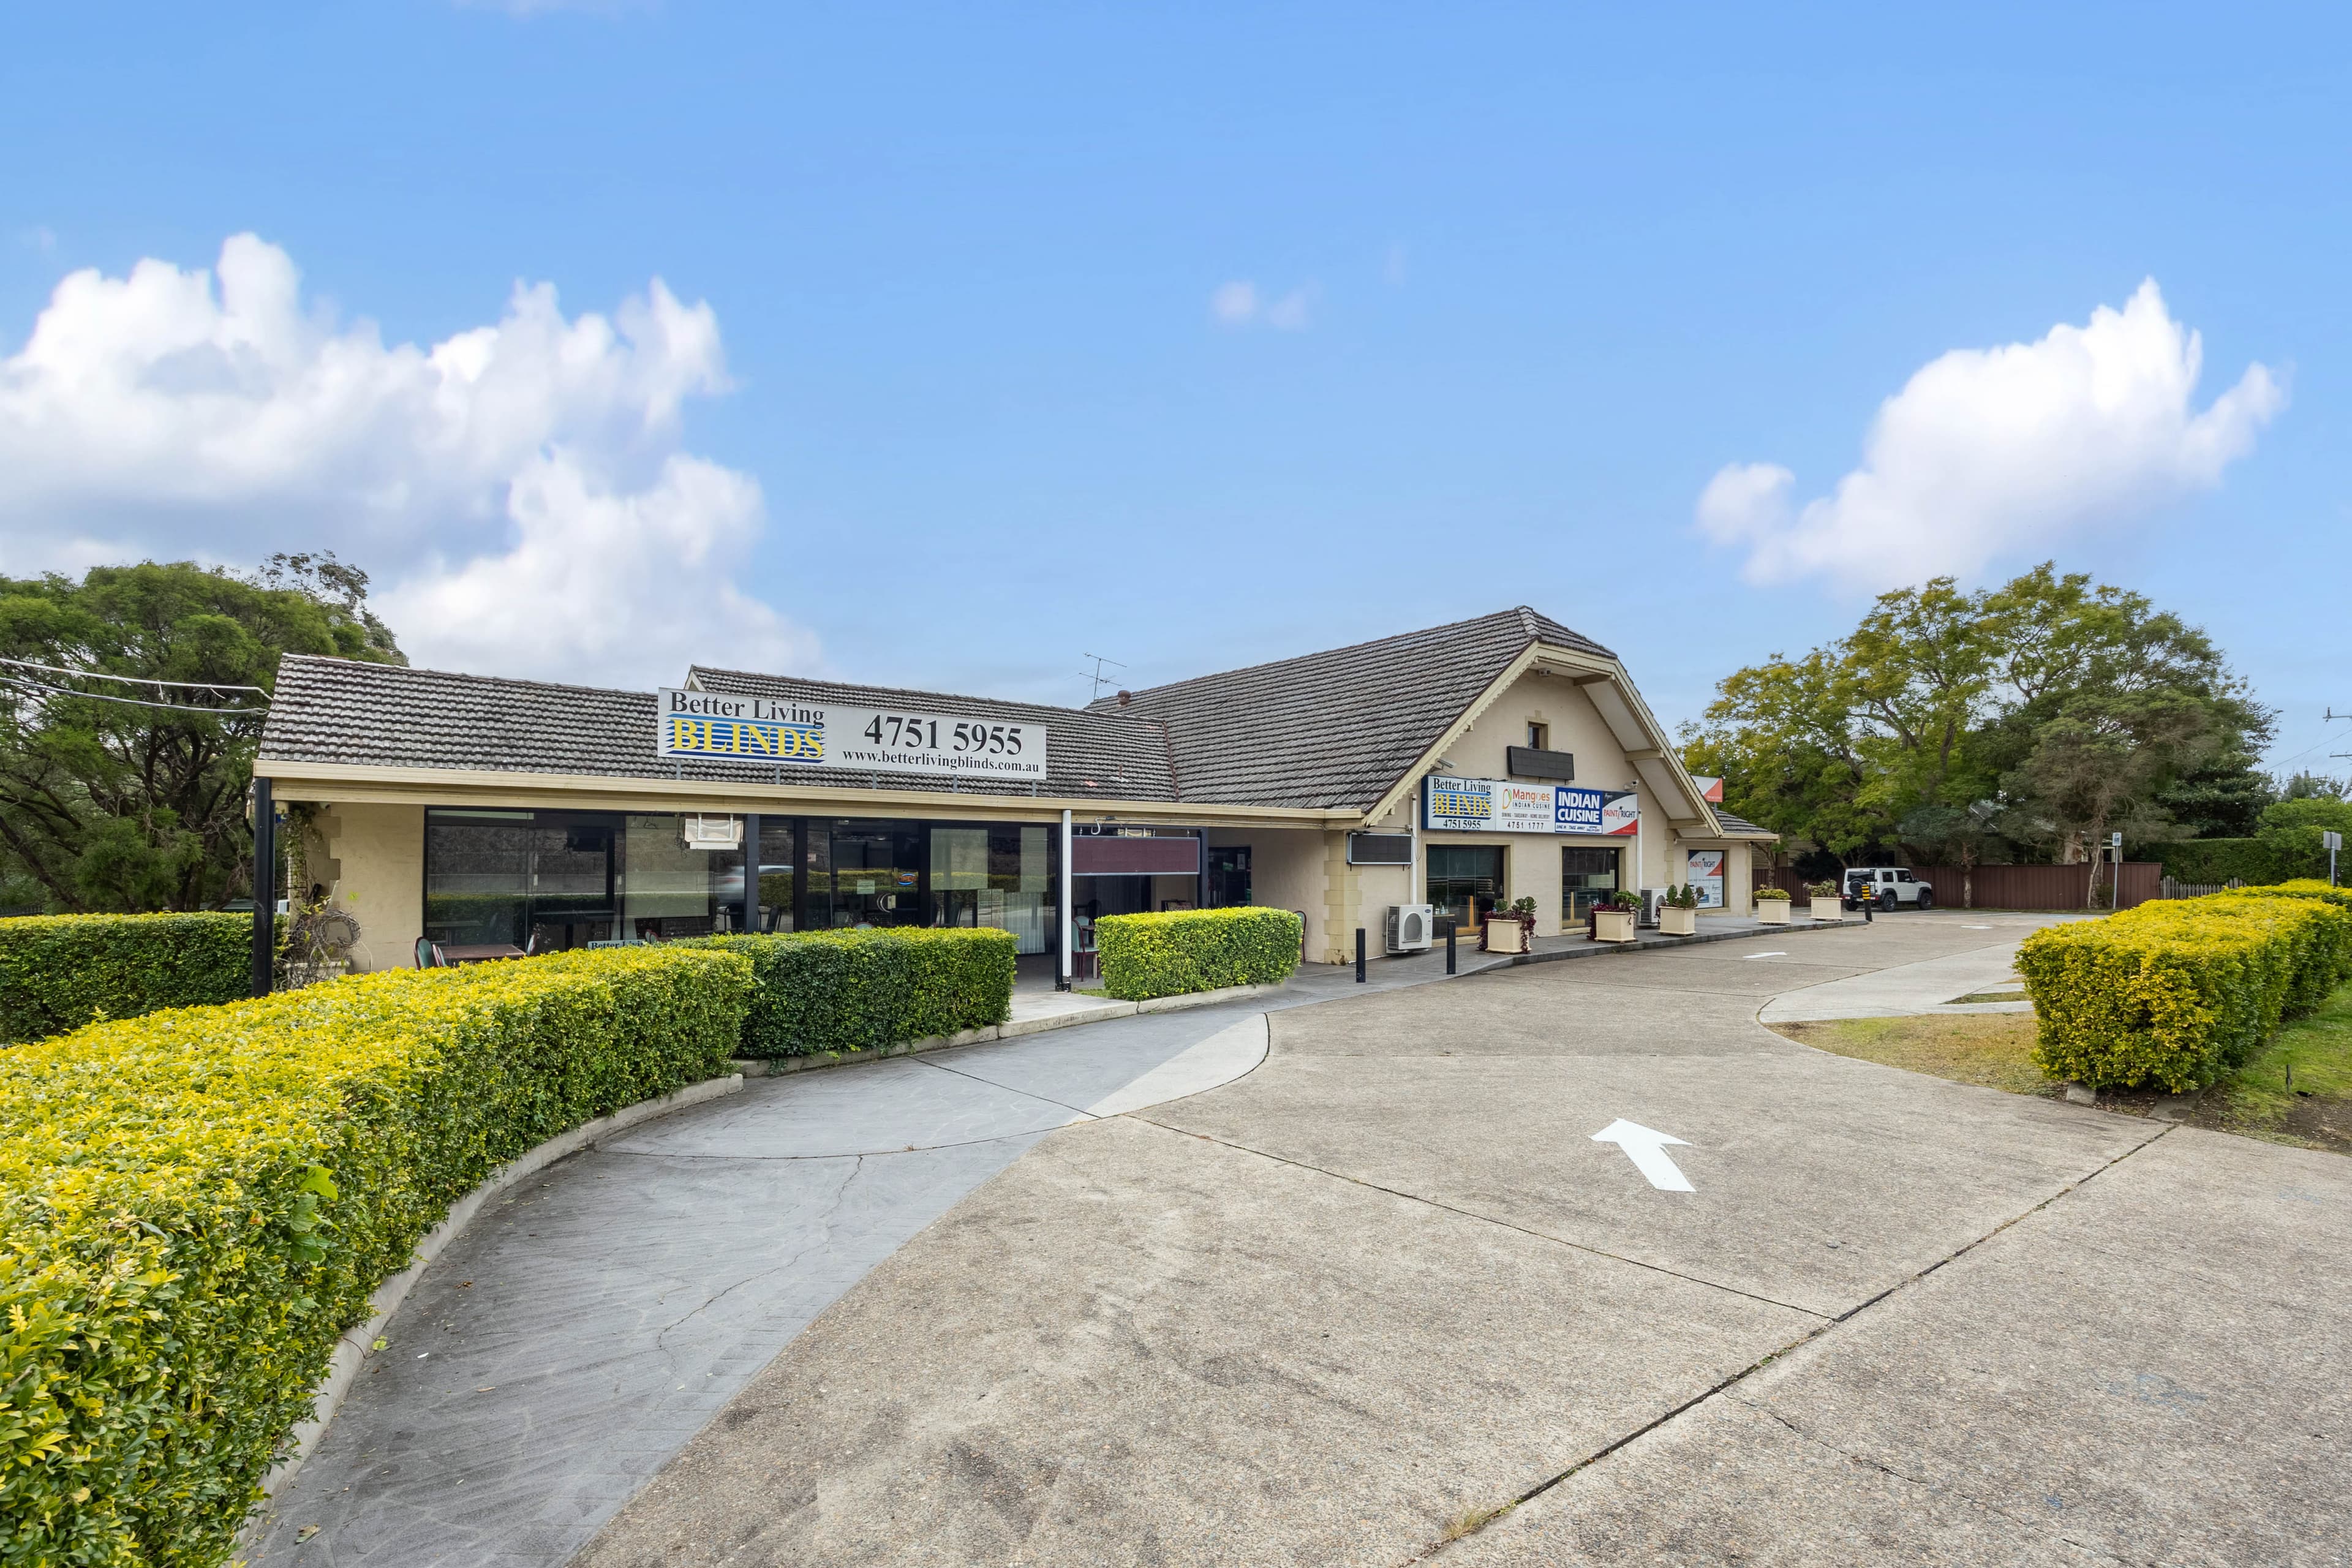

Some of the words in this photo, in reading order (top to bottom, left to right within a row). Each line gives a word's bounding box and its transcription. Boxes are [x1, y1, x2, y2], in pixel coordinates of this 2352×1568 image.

[669, 692, 745, 717] Better
[753, 699, 824, 729] Living
[670, 718, 824, 758] BLINDS
[864, 715, 940, 749] 4751
[953, 723, 1022, 755] 5955
[843, 750, 1039, 772] www.betterlivingblinds.com.au
[1433, 778, 1461, 791] Better
[1464, 780, 1491, 796] Living
[1435, 793, 1491, 816] BLINDS
[1558, 791, 1600, 809] INDIAN
[1443, 819, 1461, 828] 4751
[1463, 820, 1481, 829] 5955
[1558, 808, 1600, 823] CUISINE
[1621, 810, 1635, 818] RIGHT
